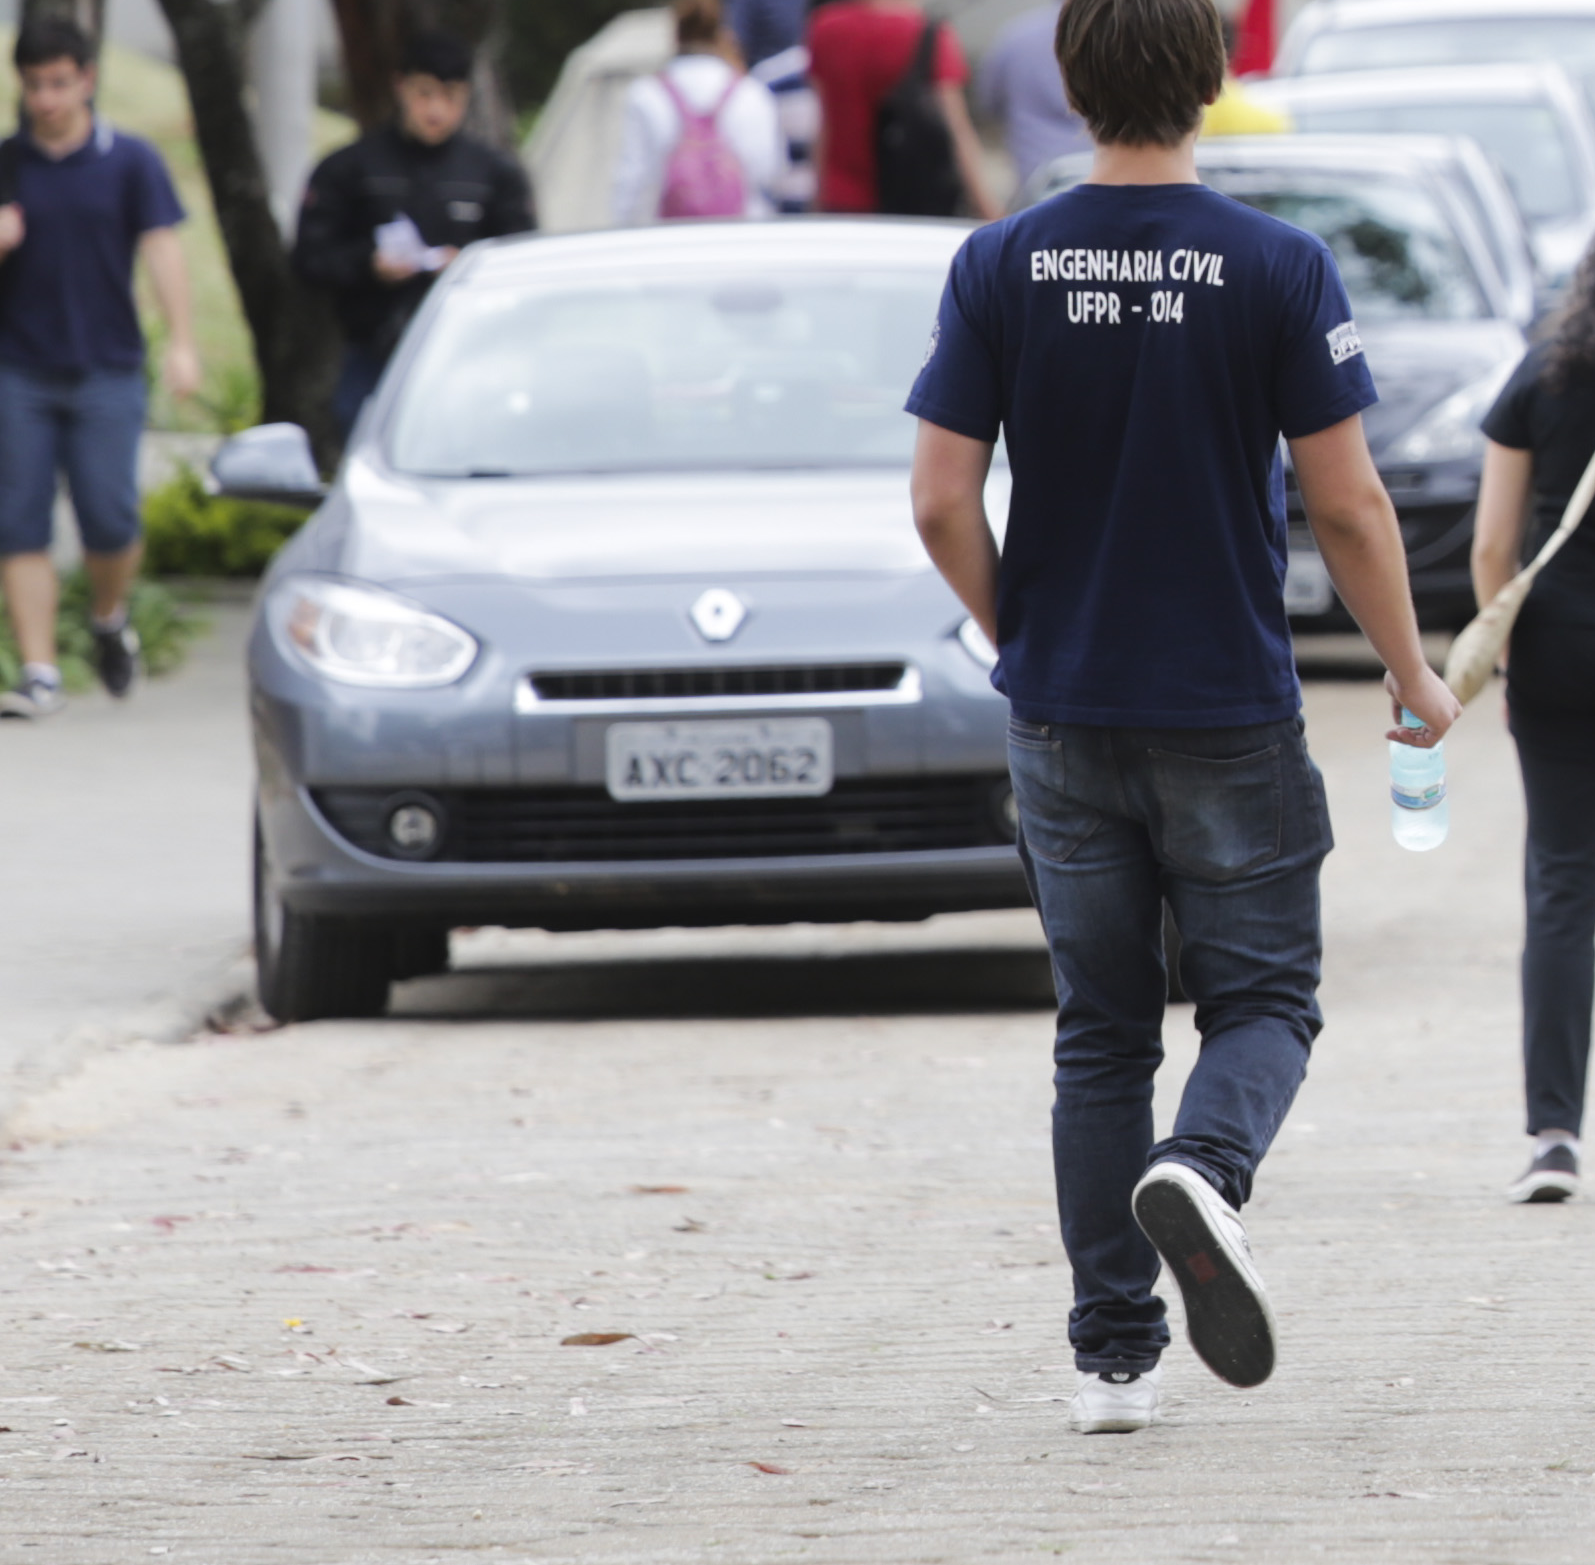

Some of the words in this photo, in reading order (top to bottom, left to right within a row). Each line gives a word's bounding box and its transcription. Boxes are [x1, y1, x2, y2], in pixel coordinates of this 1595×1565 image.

[1031, 248, 1164, 283] ENGENHARIA
[1169, 248, 1225, 287] CIVIL
[1067, 290, 1122, 325] UFPR
[624, 748, 697, 787] AXC
[714, 745, 818, 785] 2062
